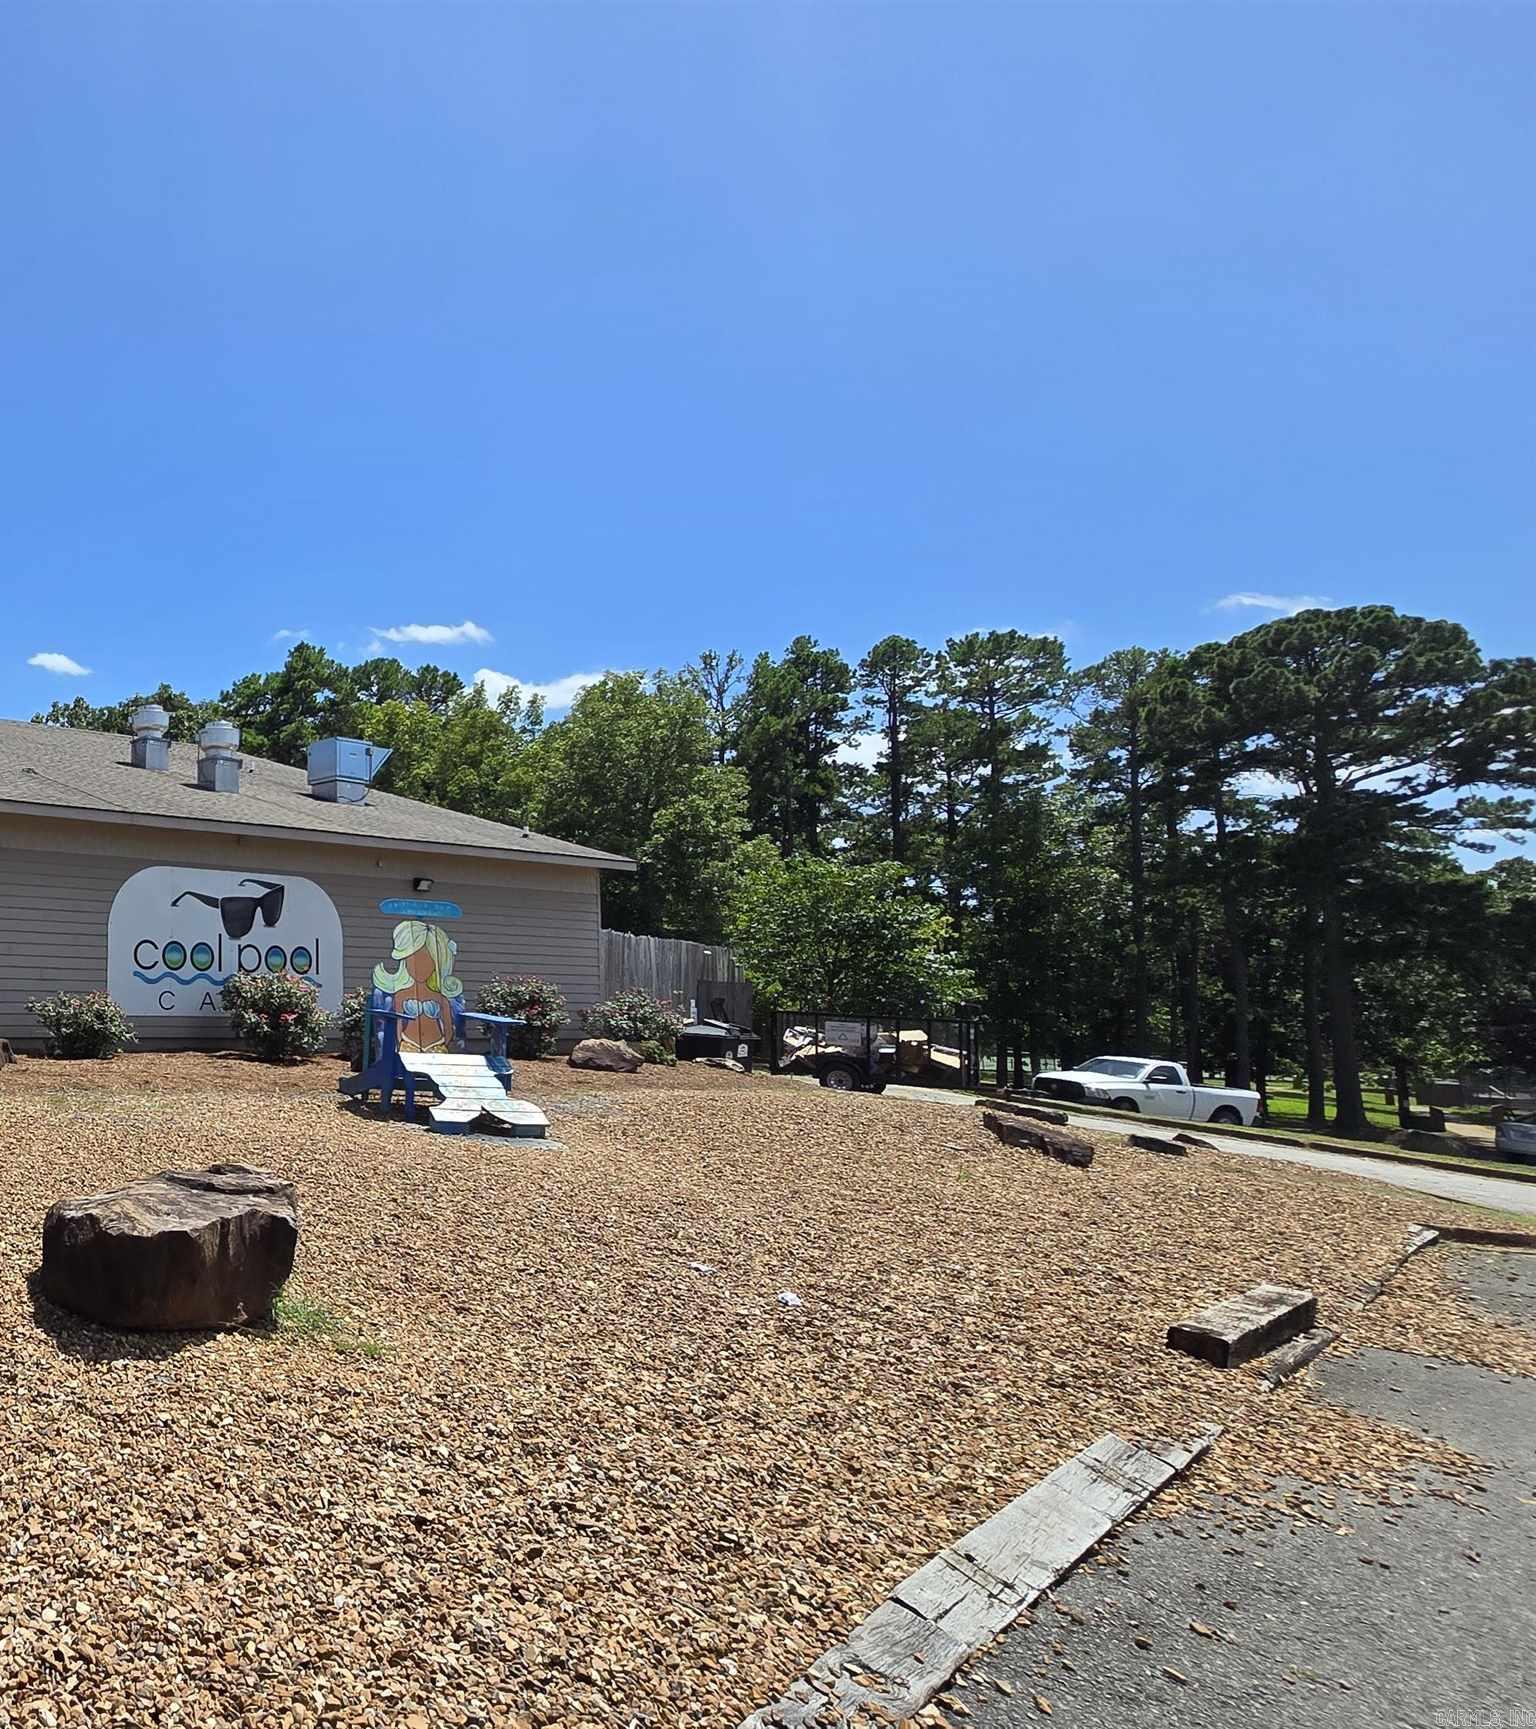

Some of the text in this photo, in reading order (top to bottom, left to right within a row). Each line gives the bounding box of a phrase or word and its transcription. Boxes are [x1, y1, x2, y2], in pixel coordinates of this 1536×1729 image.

[133, 933, 319, 975] cool pool
[159, 991, 217, 1011] CA
